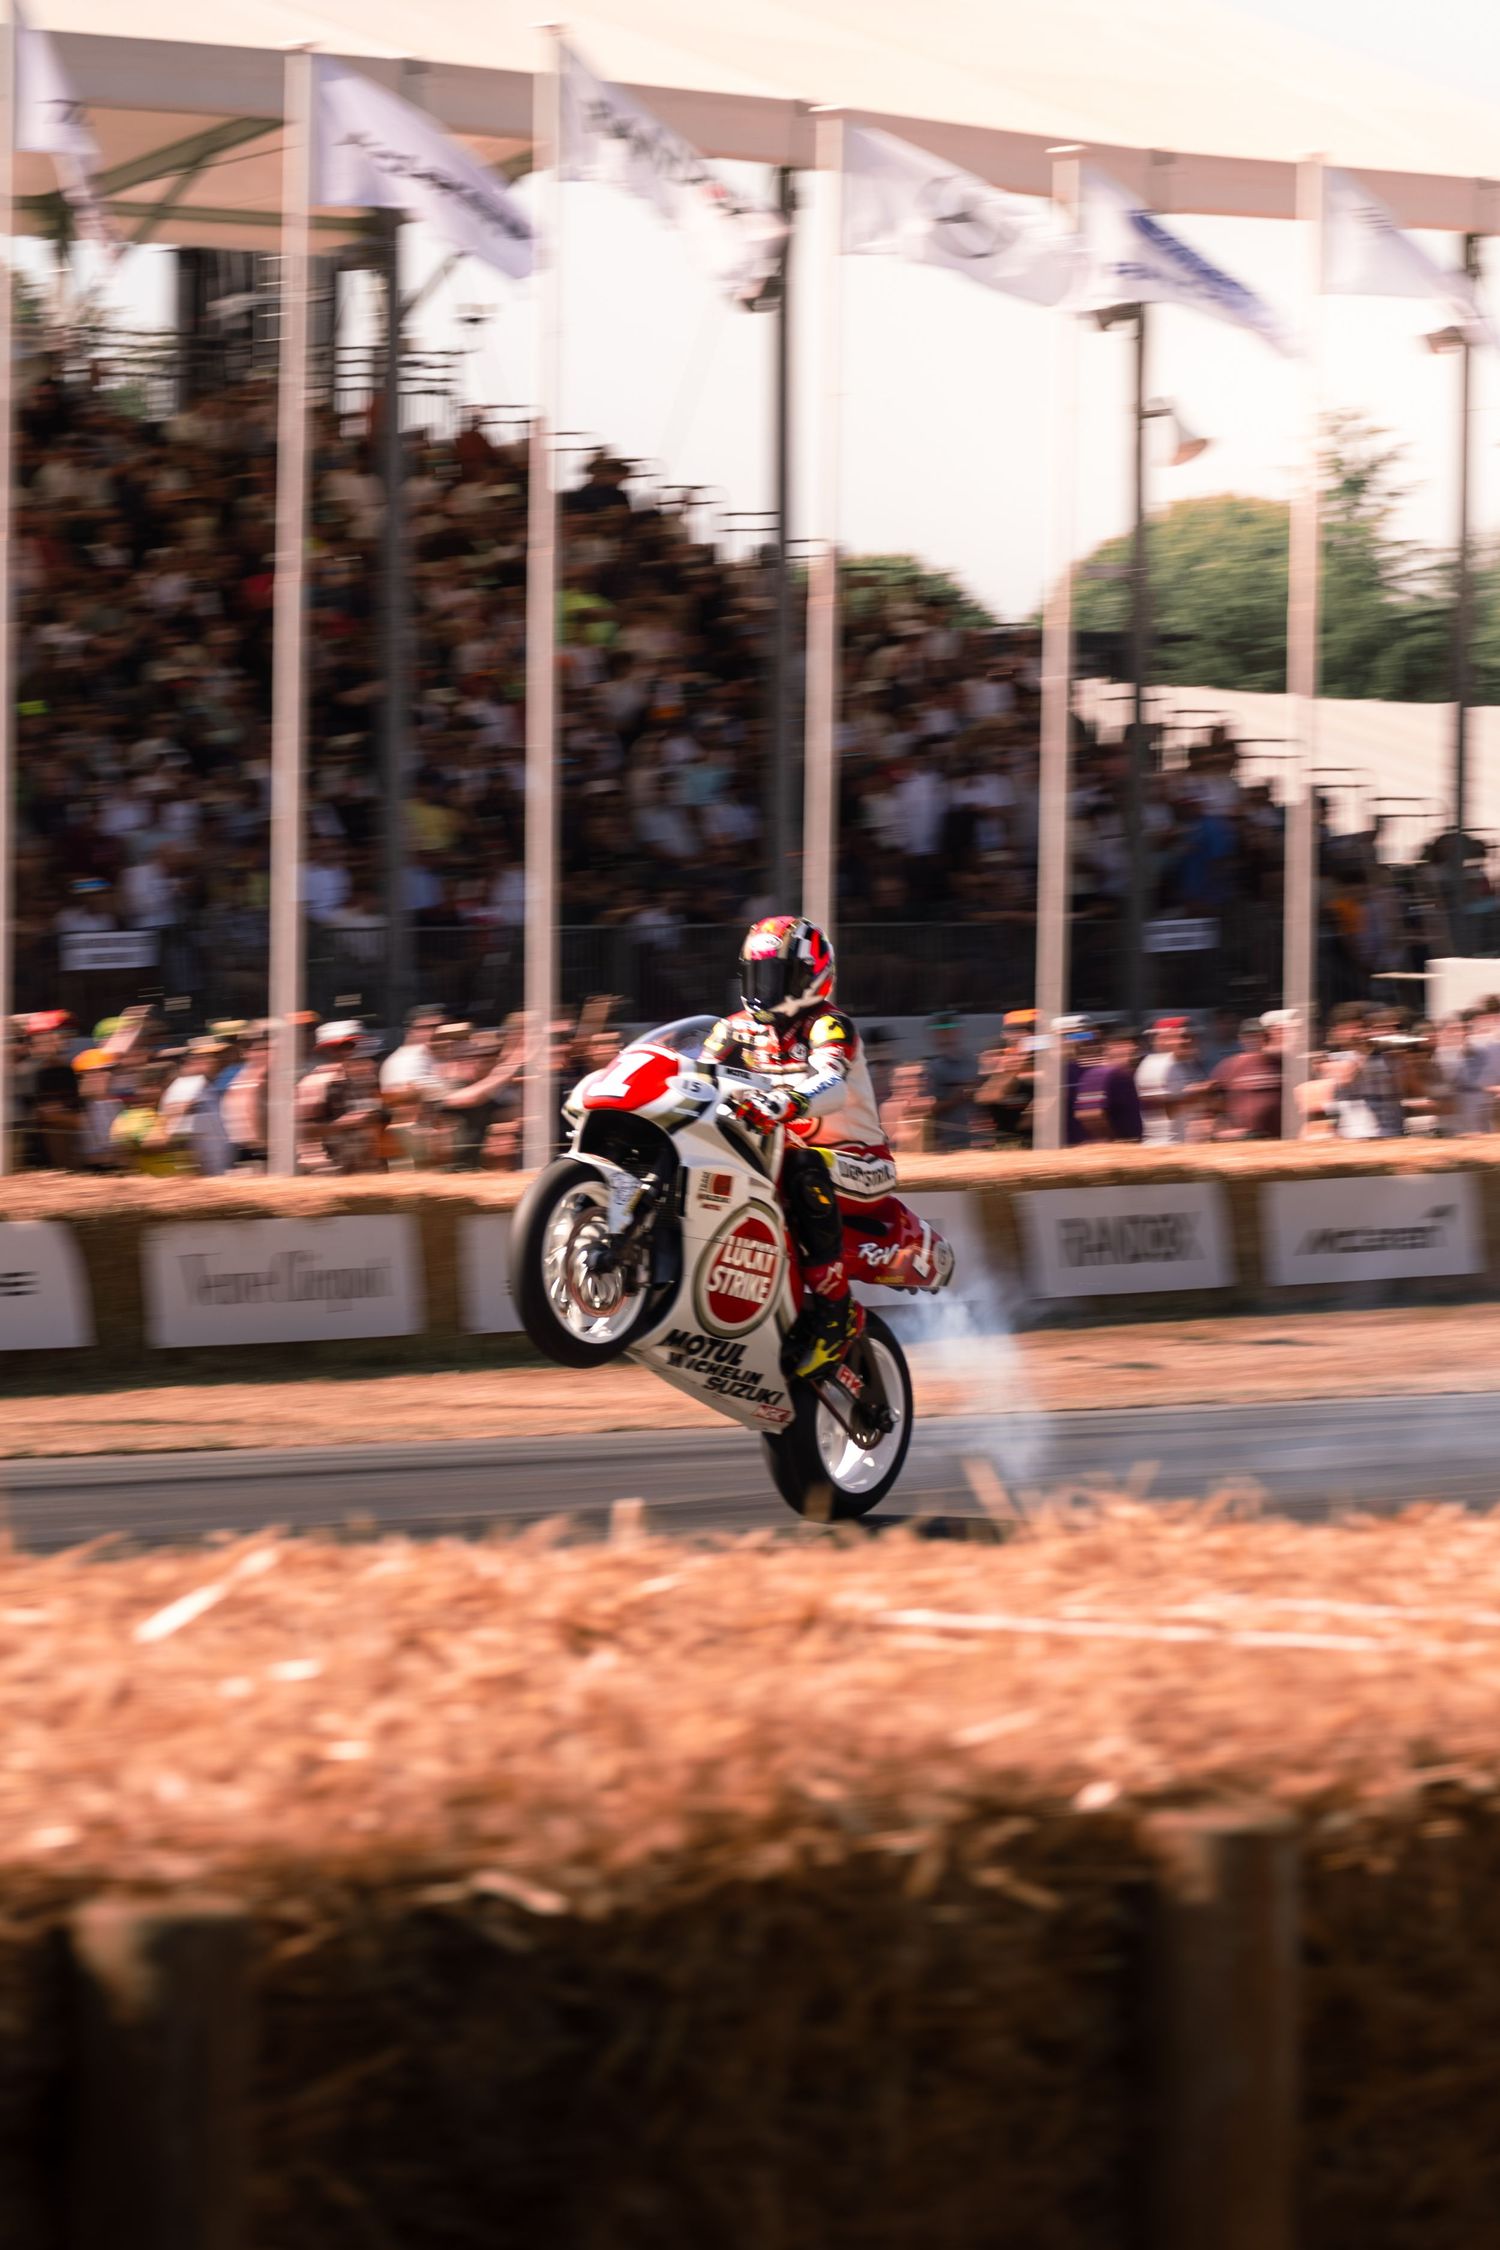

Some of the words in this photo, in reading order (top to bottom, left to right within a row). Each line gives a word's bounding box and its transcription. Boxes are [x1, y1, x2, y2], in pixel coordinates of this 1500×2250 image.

[586, 1053, 655, 1098] 1
[722, 1236, 777, 1273] LUCKY
[912, 1220, 931, 1278] 1
[706, 1265, 772, 1305] STRIKE
[655, 1328, 748, 1367] MOTUL
[667, 1352, 765, 1386] MICHELIN
[702, 1376, 785, 1406] SUZUKI
